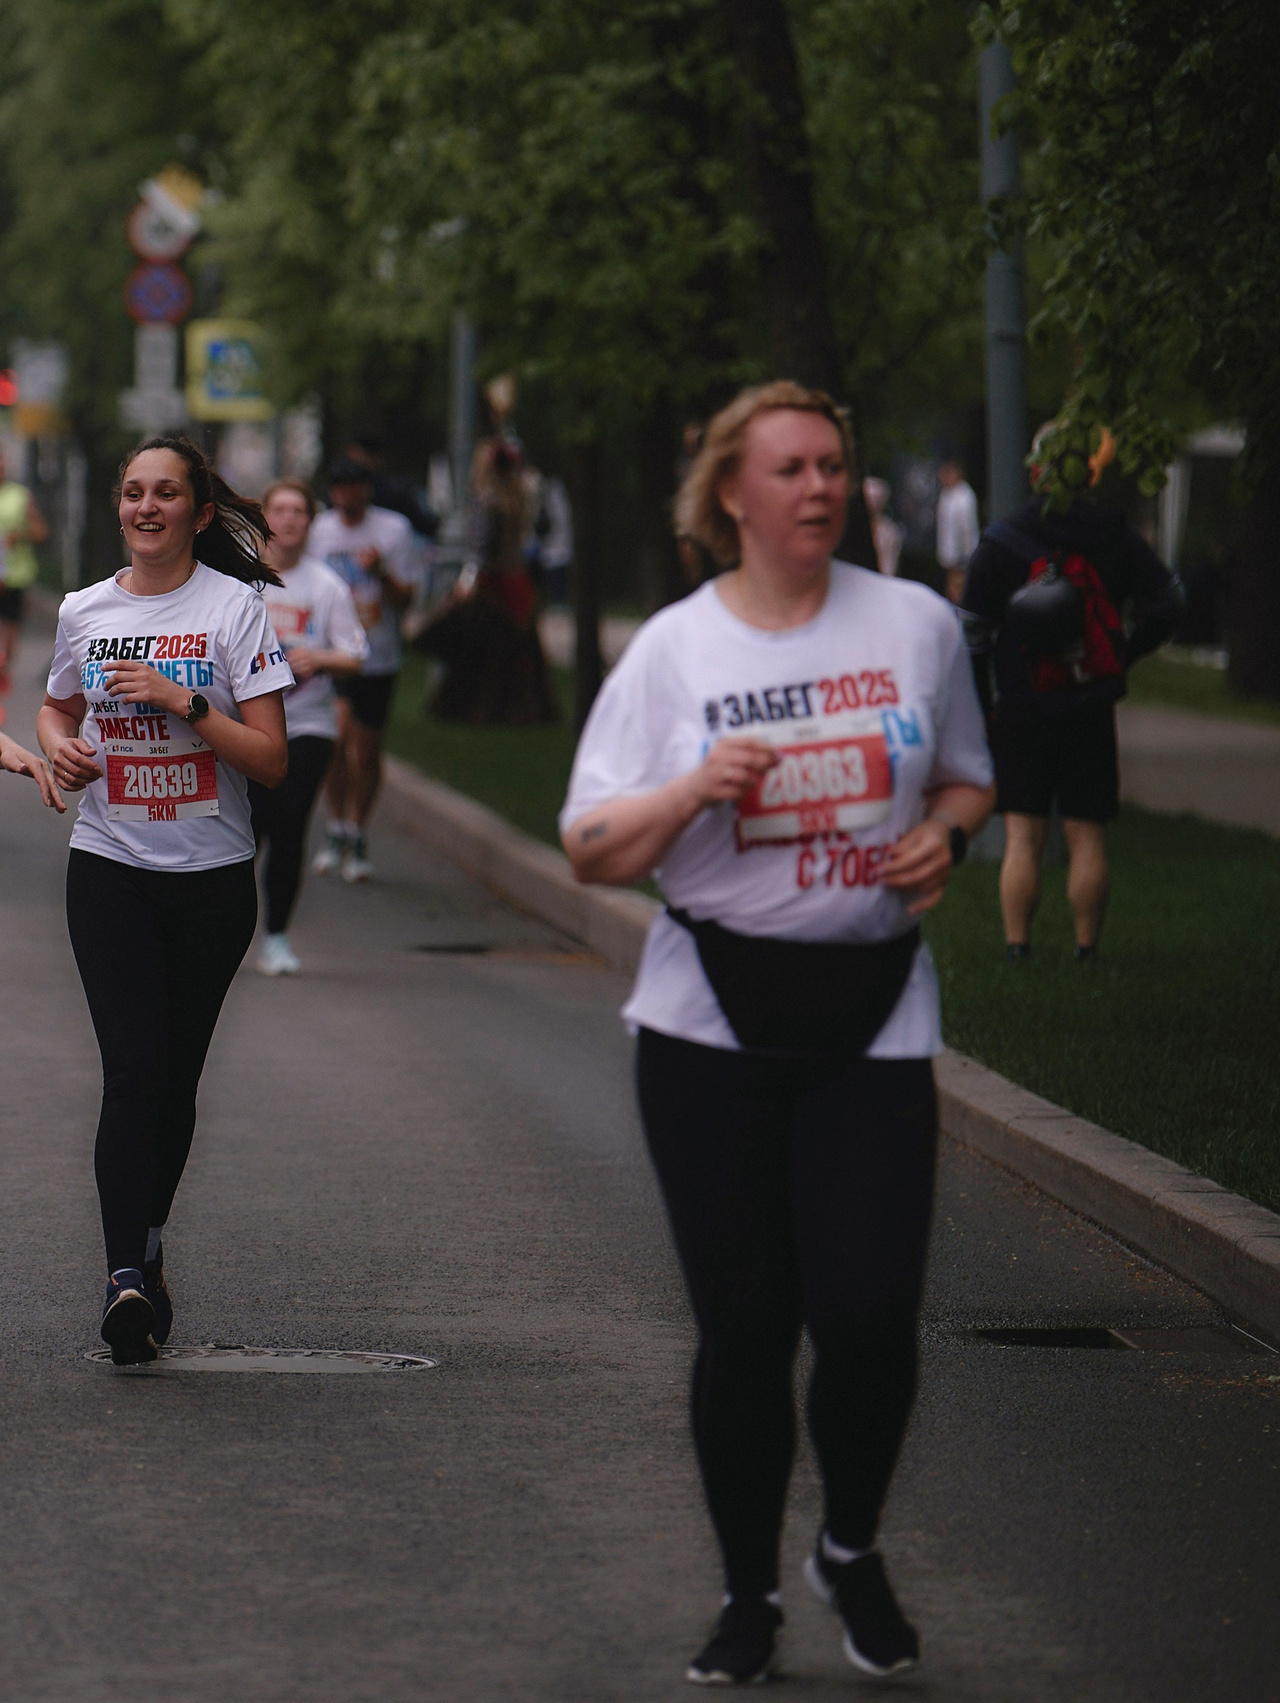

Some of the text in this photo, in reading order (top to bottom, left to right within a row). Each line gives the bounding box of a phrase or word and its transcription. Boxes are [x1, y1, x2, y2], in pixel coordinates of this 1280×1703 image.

[87, 632, 207, 662] #ЗАБЕГ2025
[704, 668, 900, 731] #ЗАБЕГ2025
[123, 762, 199, 799] 20339
